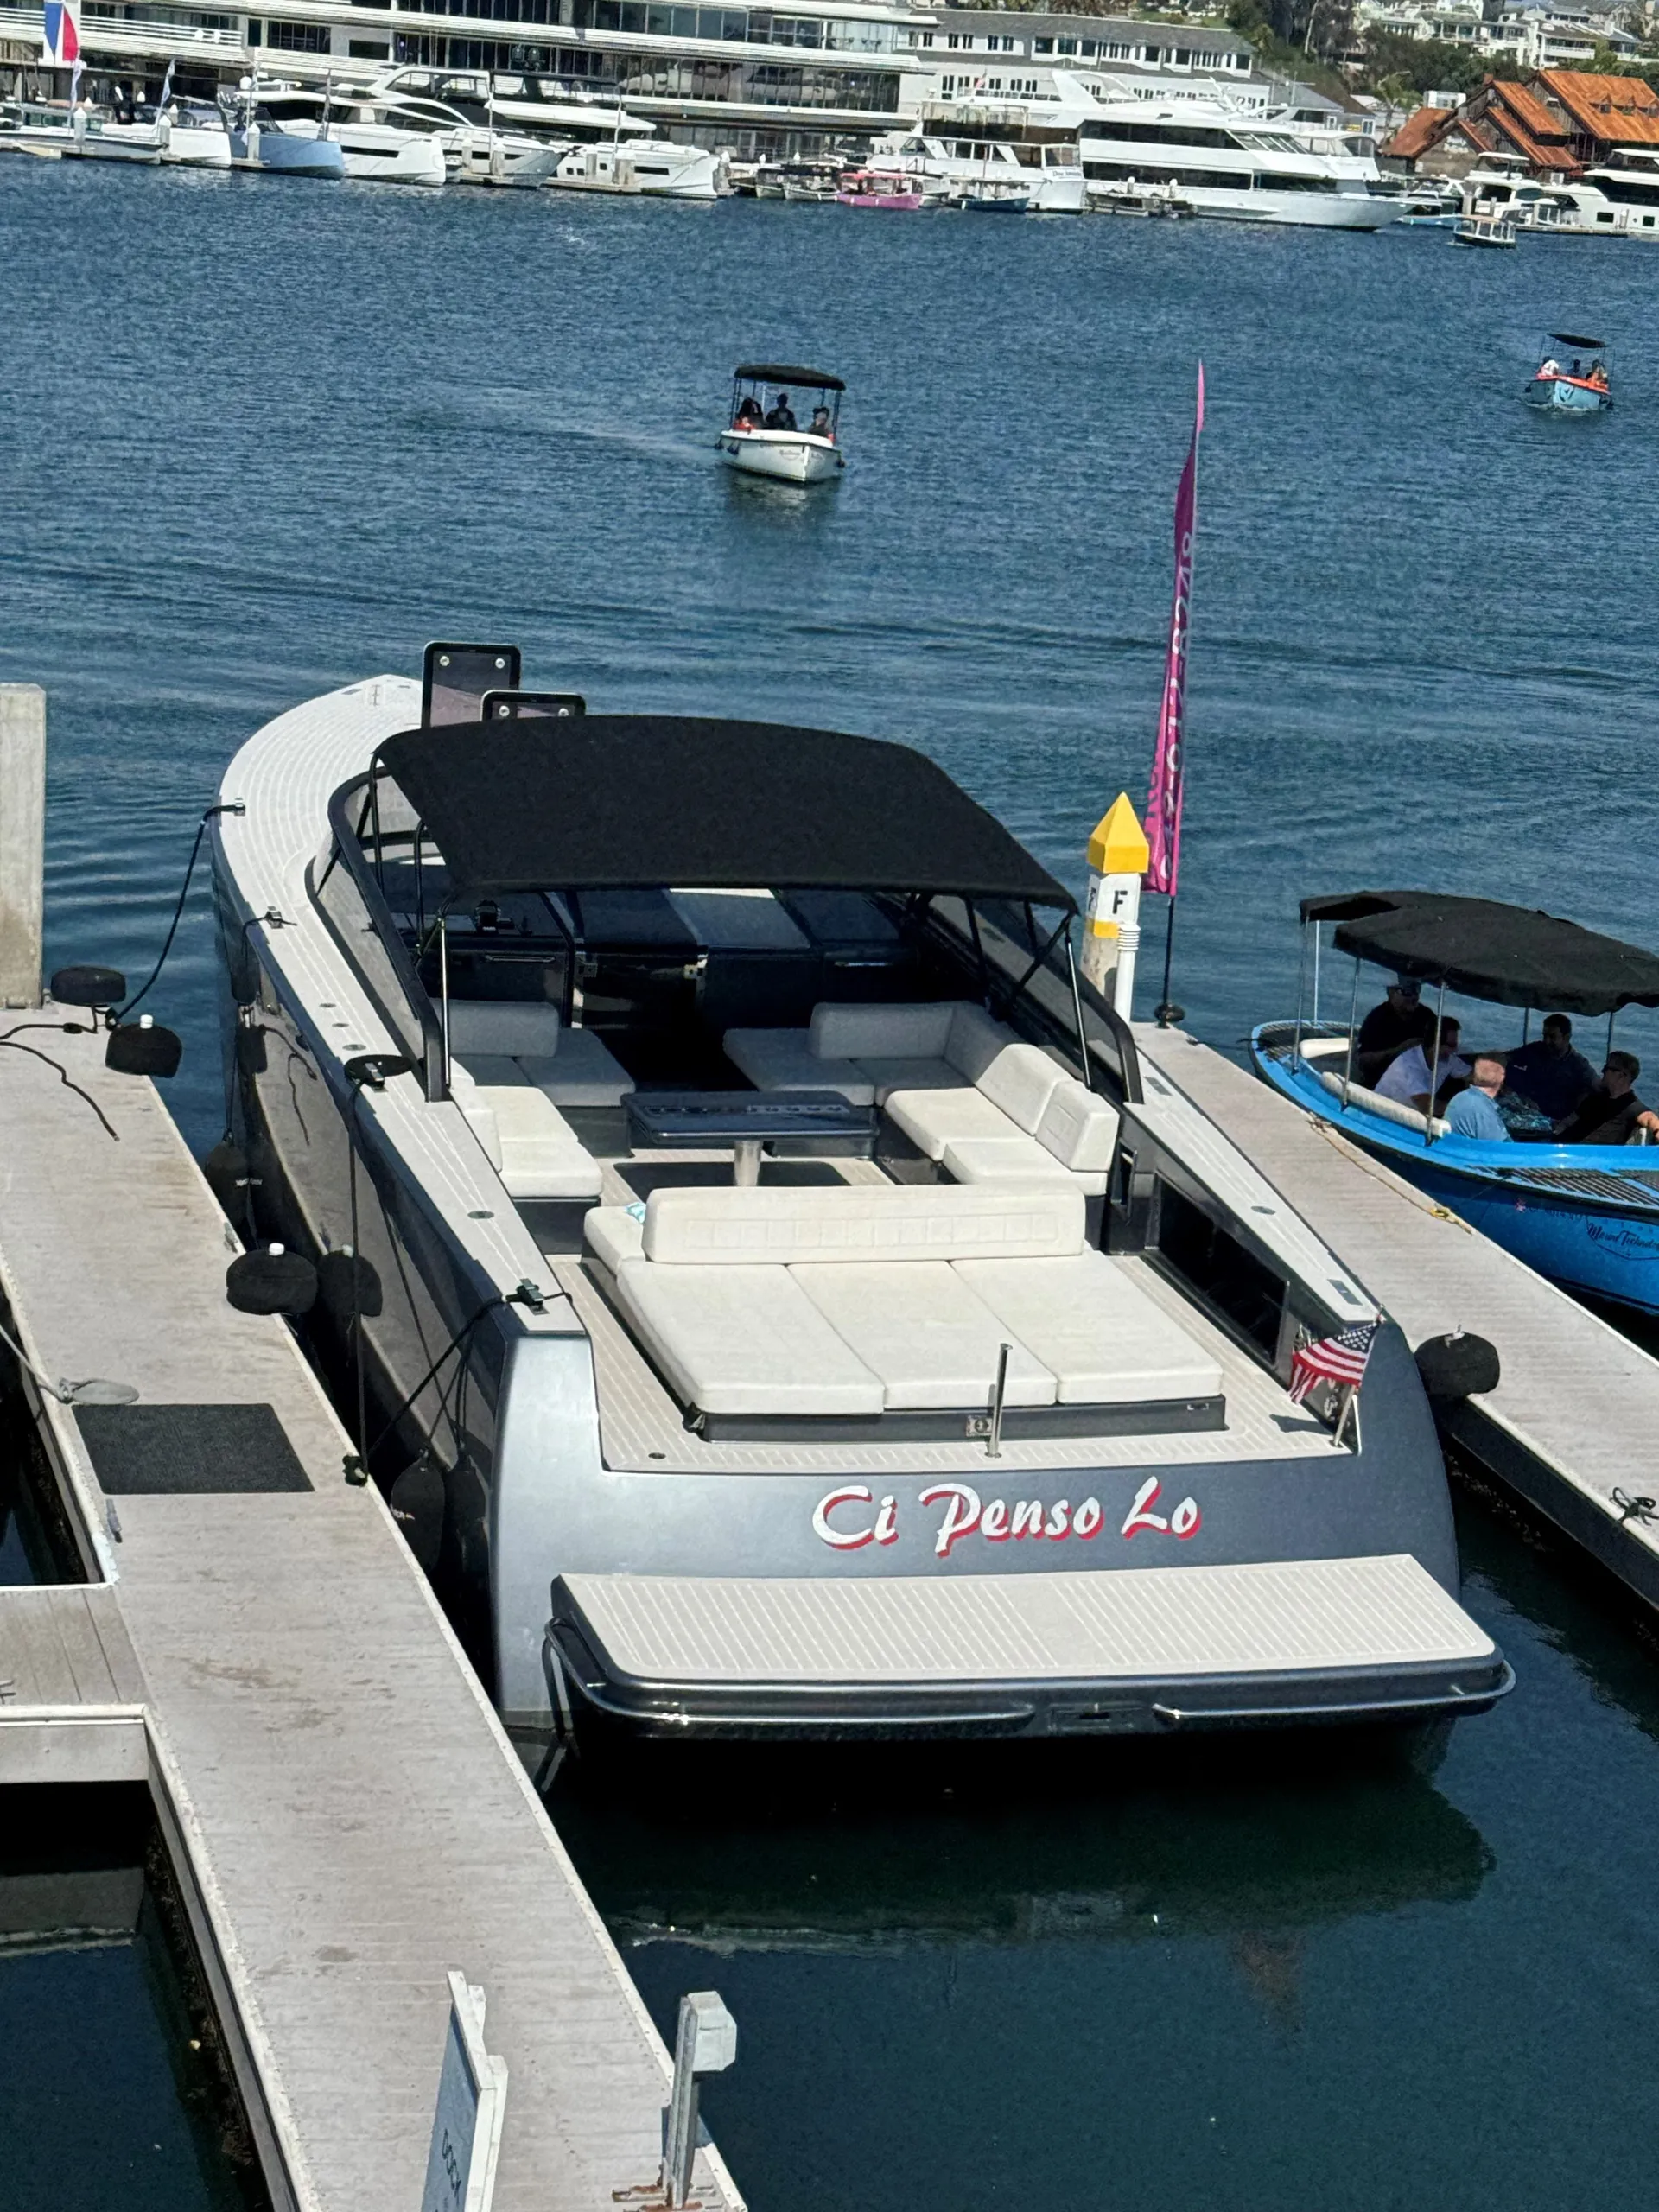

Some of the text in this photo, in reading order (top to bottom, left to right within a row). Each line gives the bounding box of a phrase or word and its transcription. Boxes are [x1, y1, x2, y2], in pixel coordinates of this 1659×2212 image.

[1112, 890, 1128, 915] F
[812, 1475, 1202, 1558] Ci Penso Lo
